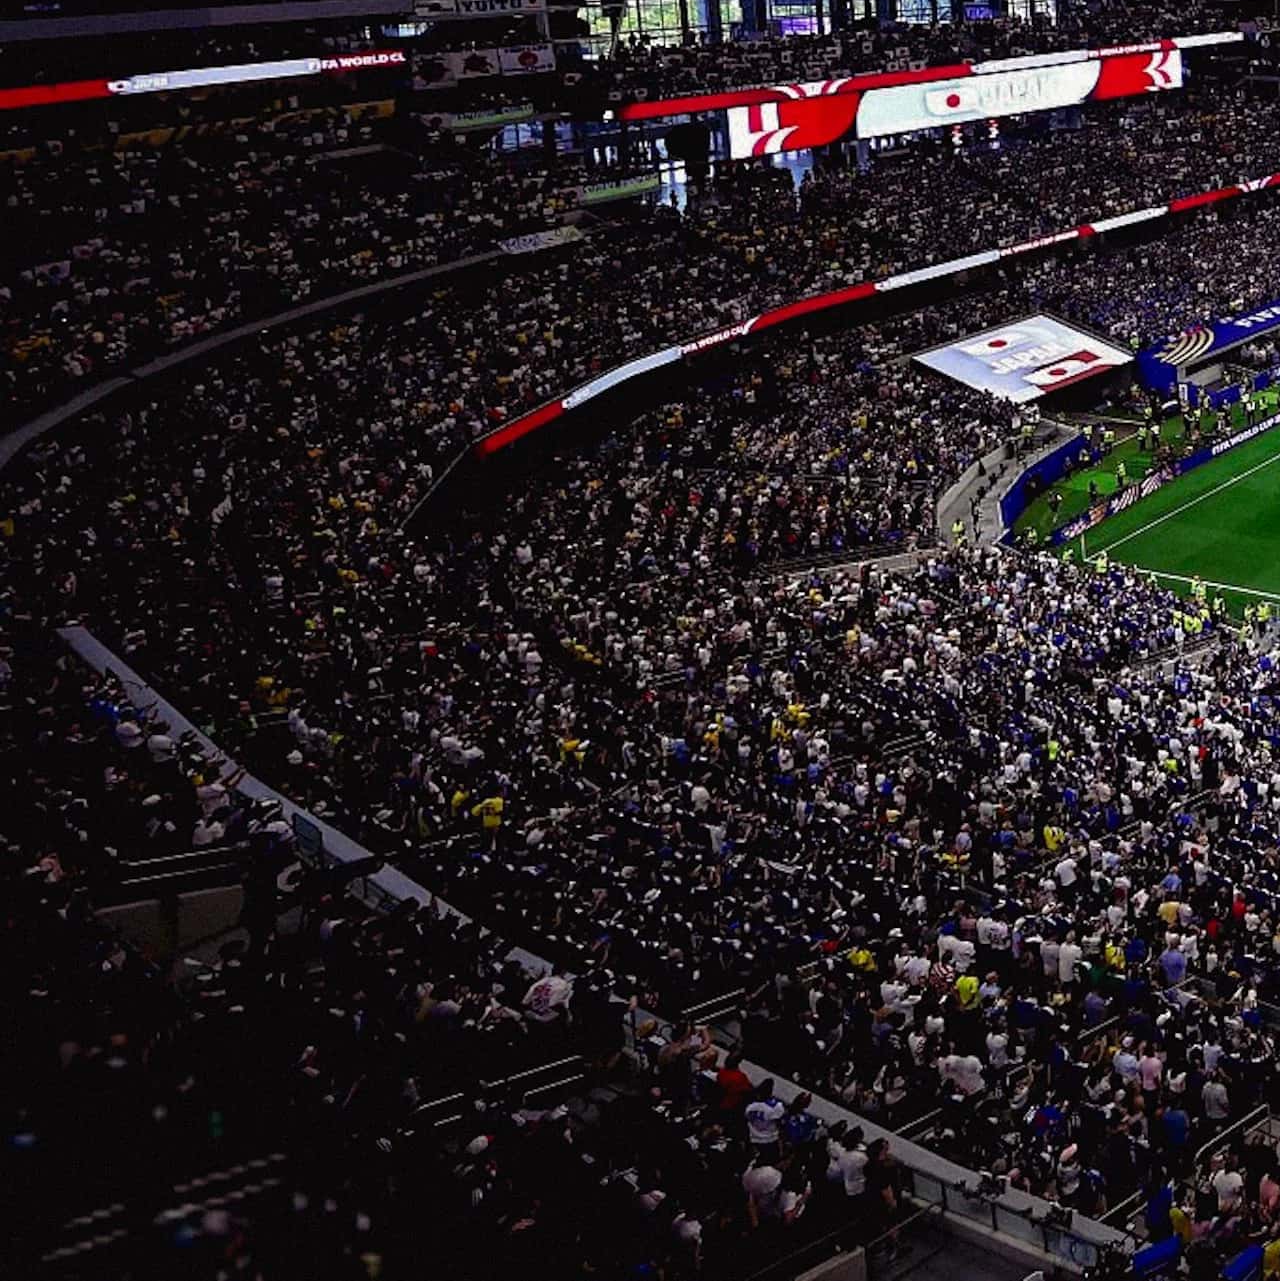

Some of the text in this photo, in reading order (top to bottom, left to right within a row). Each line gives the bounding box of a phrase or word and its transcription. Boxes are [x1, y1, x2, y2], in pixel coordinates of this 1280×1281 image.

[339, 54, 389, 68] WORLD
[1211, 441, 1231, 456] FIFA
[1230, 425, 1259, 446] WORLD
